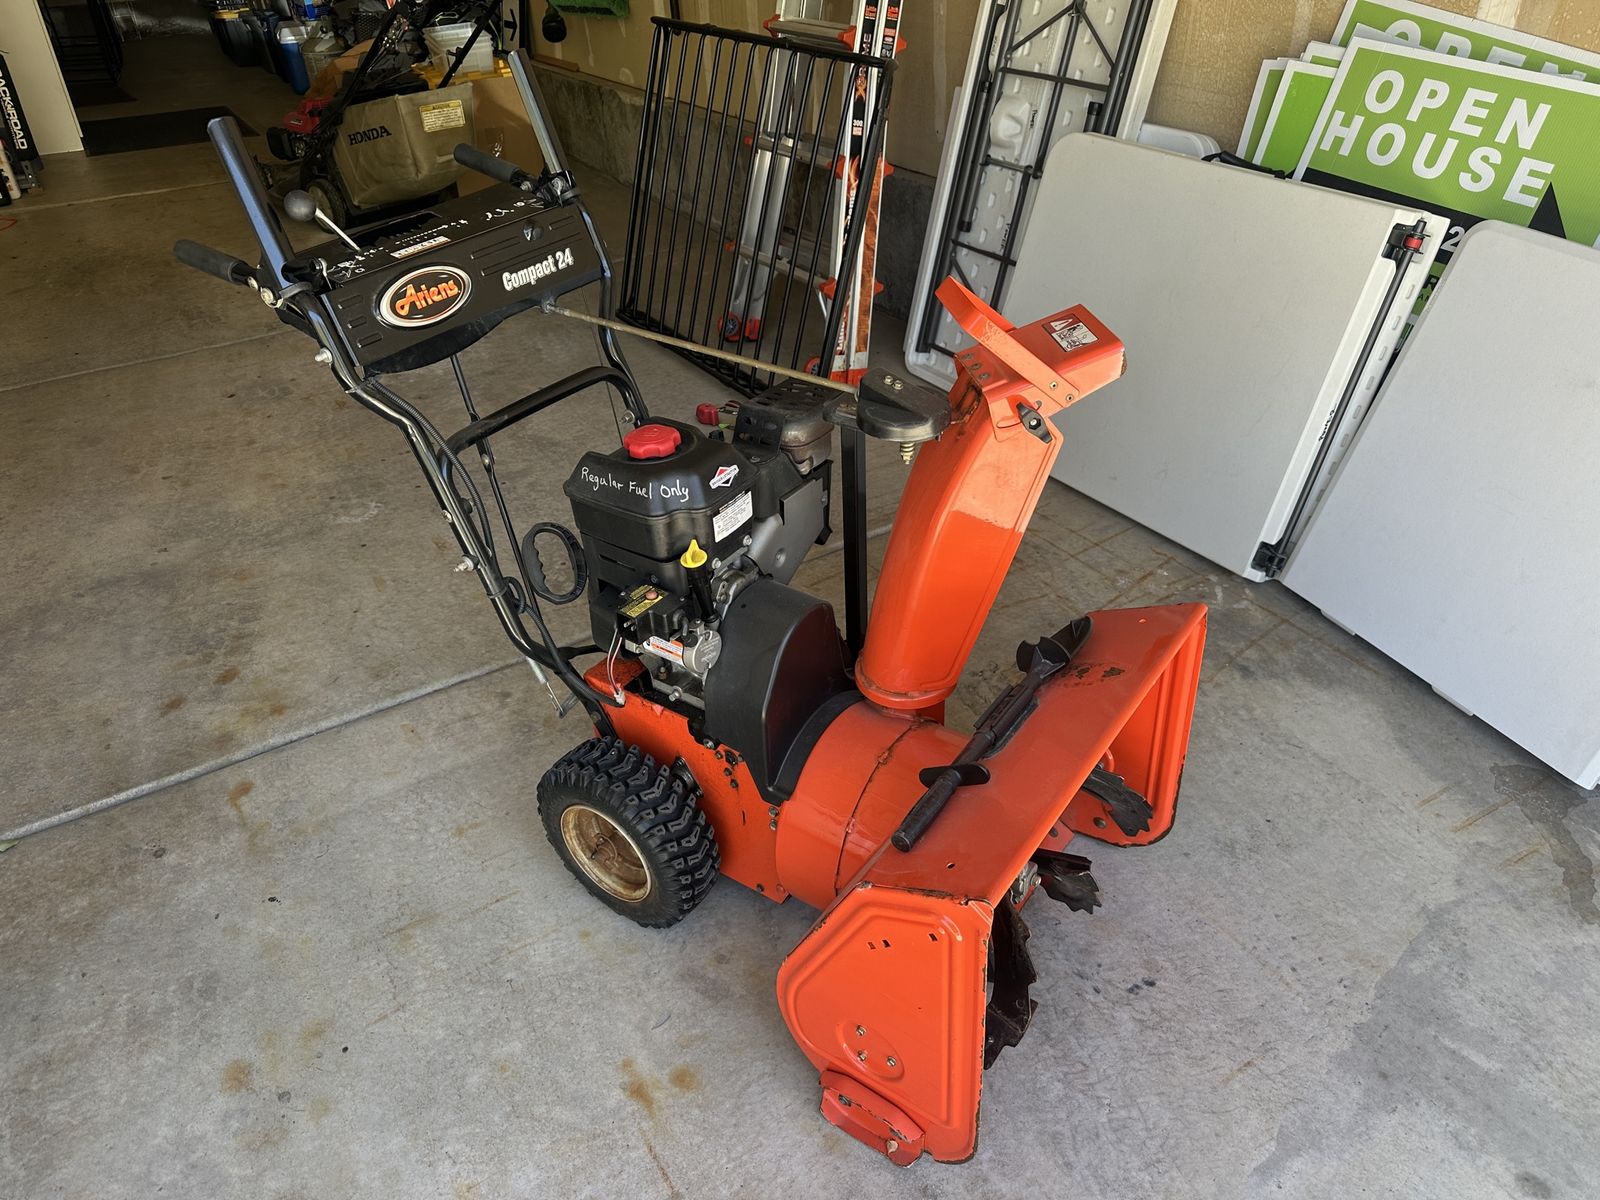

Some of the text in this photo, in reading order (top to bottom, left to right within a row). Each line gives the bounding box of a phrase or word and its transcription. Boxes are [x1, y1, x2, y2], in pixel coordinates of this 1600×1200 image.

[1364, 69, 1552, 150] OPEN
[347, 125, 392, 146] HONDA
[1319, 109, 1555, 208] HOUSE
[502, 247, 575, 292] Compact 24
[395, 278, 460, 316] Ariens
[581, 466, 690, 503] Regular Fuel Only
